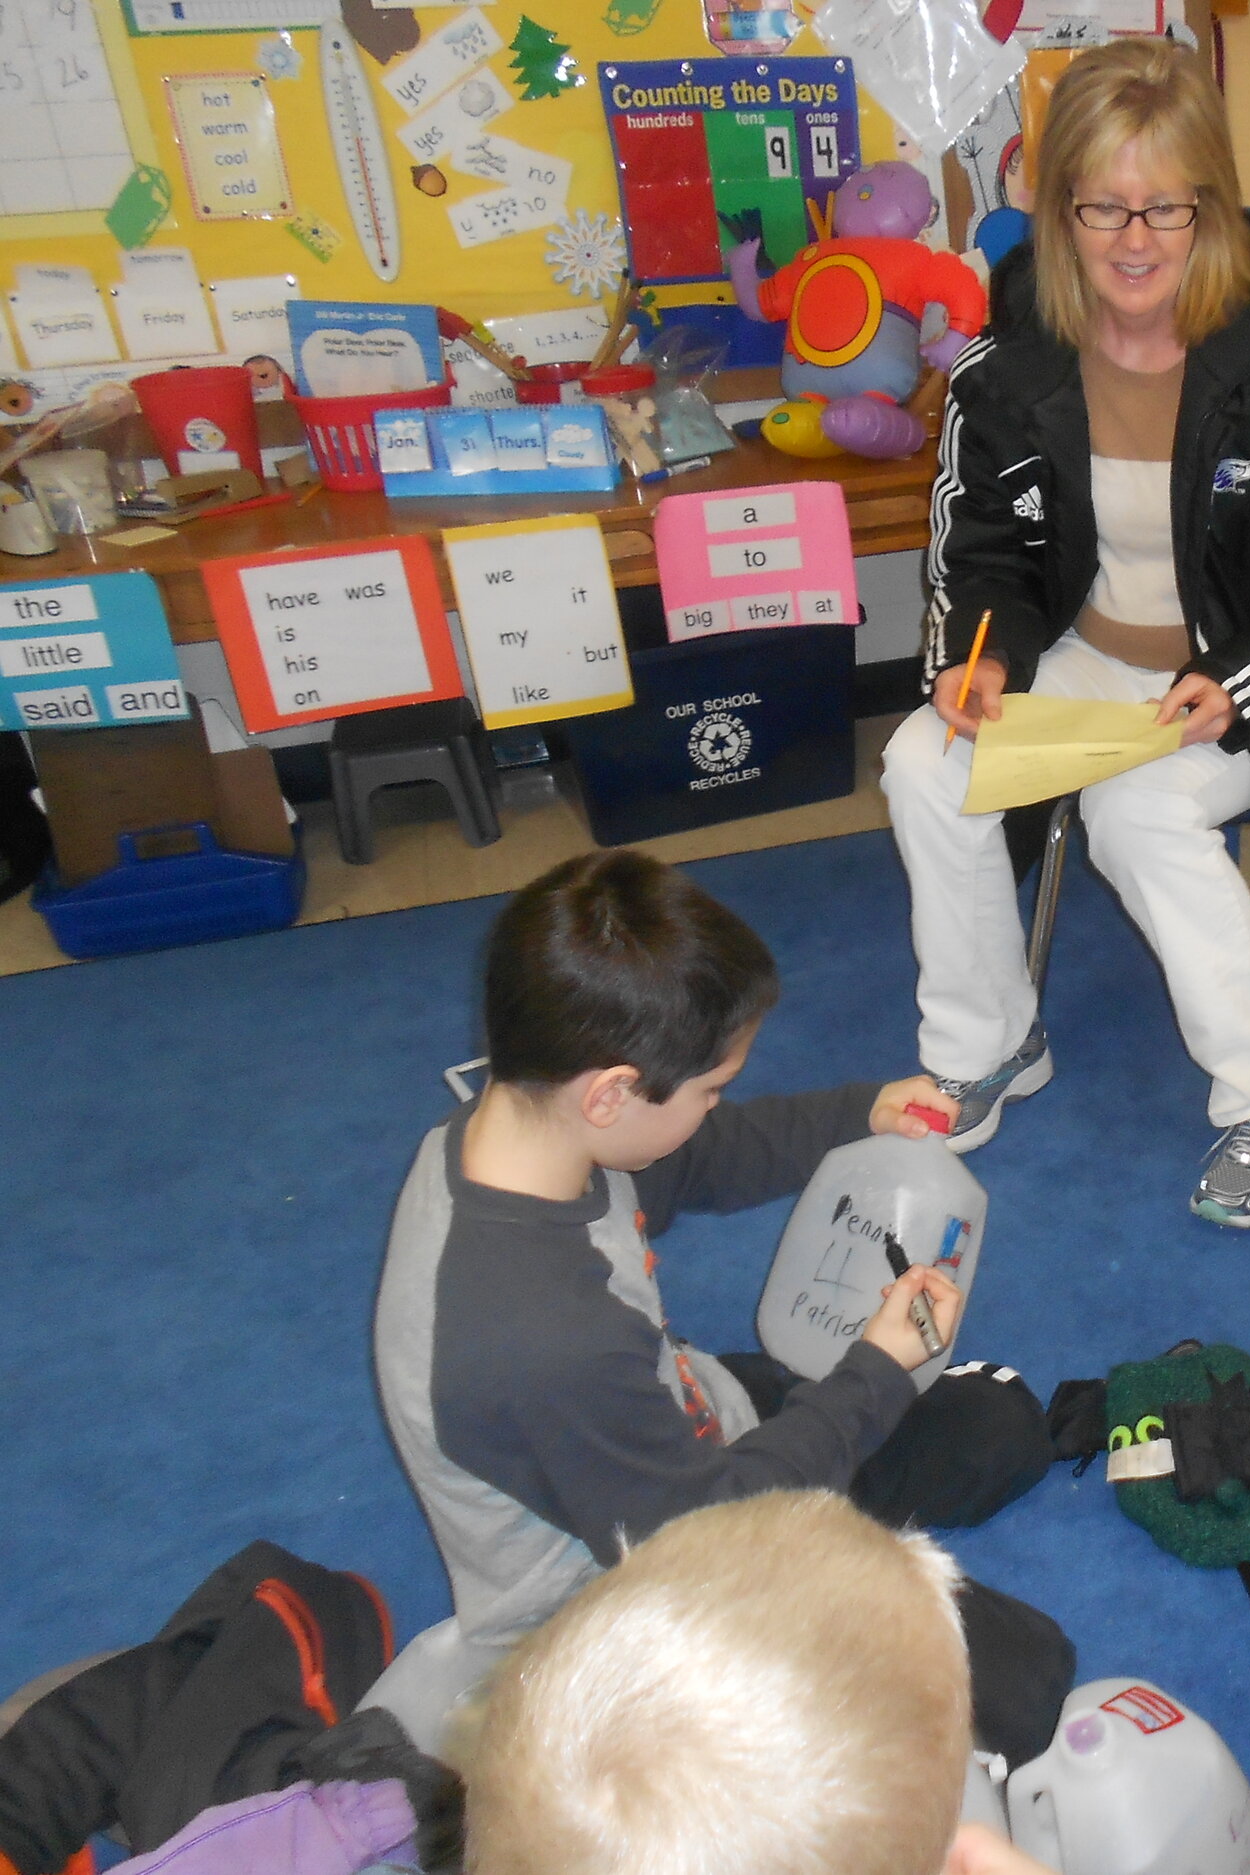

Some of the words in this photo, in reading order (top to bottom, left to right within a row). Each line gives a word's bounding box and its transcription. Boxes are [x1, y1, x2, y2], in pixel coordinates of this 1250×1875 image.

[57, 54, 89, 88] 26
[202, 92, 232, 107] hot
[396, 71, 427, 108] yes
[612, 80, 725, 109] Counting
[730, 79, 771, 105] the
[778, 78, 839, 107] Days
[201, 120, 249, 136] warm
[626, 113, 694, 129] hundreds
[735, 112, 765, 125] tens
[806, 112, 839, 124] ones
[414, 124, 444, 157] yes
[214, 150, 249, 166] cool
[770, 136, 788, 170] 9
[816, 136, 834, 169] 4
[528, 165, 556, 185] no
[221, 179, 257, 196] cold
[31, 319, 94, 336] Thursday
[143, 312, 186, 325] Friday
[386, 435, 419, 449] Jan.
[495, 435, 542, 449] Thurs.
[742, 505, 759, 524] a
[744, 547, 767, 568] to
[484, 567, 515, 586] we
[266, 589, 321, 611] have
[345, 581, 387, 601] was
[571, 587, 588, 604] it
[13, 596, 63, 620] the
[684, 608, 714, 629] big
[747, 601, 789, 622] they
[815, 597, 833, 614] at
[276, 625, 296, 643] is
[499, 628, 529, 649] my
[22, 642, 84, 668] little
[284, 653, 320, 674] his
[583, 644, 619, 665] but
[23, 693, 95, 722] said
[120, 684, 181, 713] and
[294, 688, 321, 706] on
[512, 685, 551, 706] like
[665, 702, 697, 719] OUR
[702, 692, 762, 712] SCHOOL
[690, 712, 743, 737] RECYCLE
[688, 741, 726, 772] REDUCE
[729, 730, 752, 768] REUSE
[689, 767, 761, 791] RECYCLES
